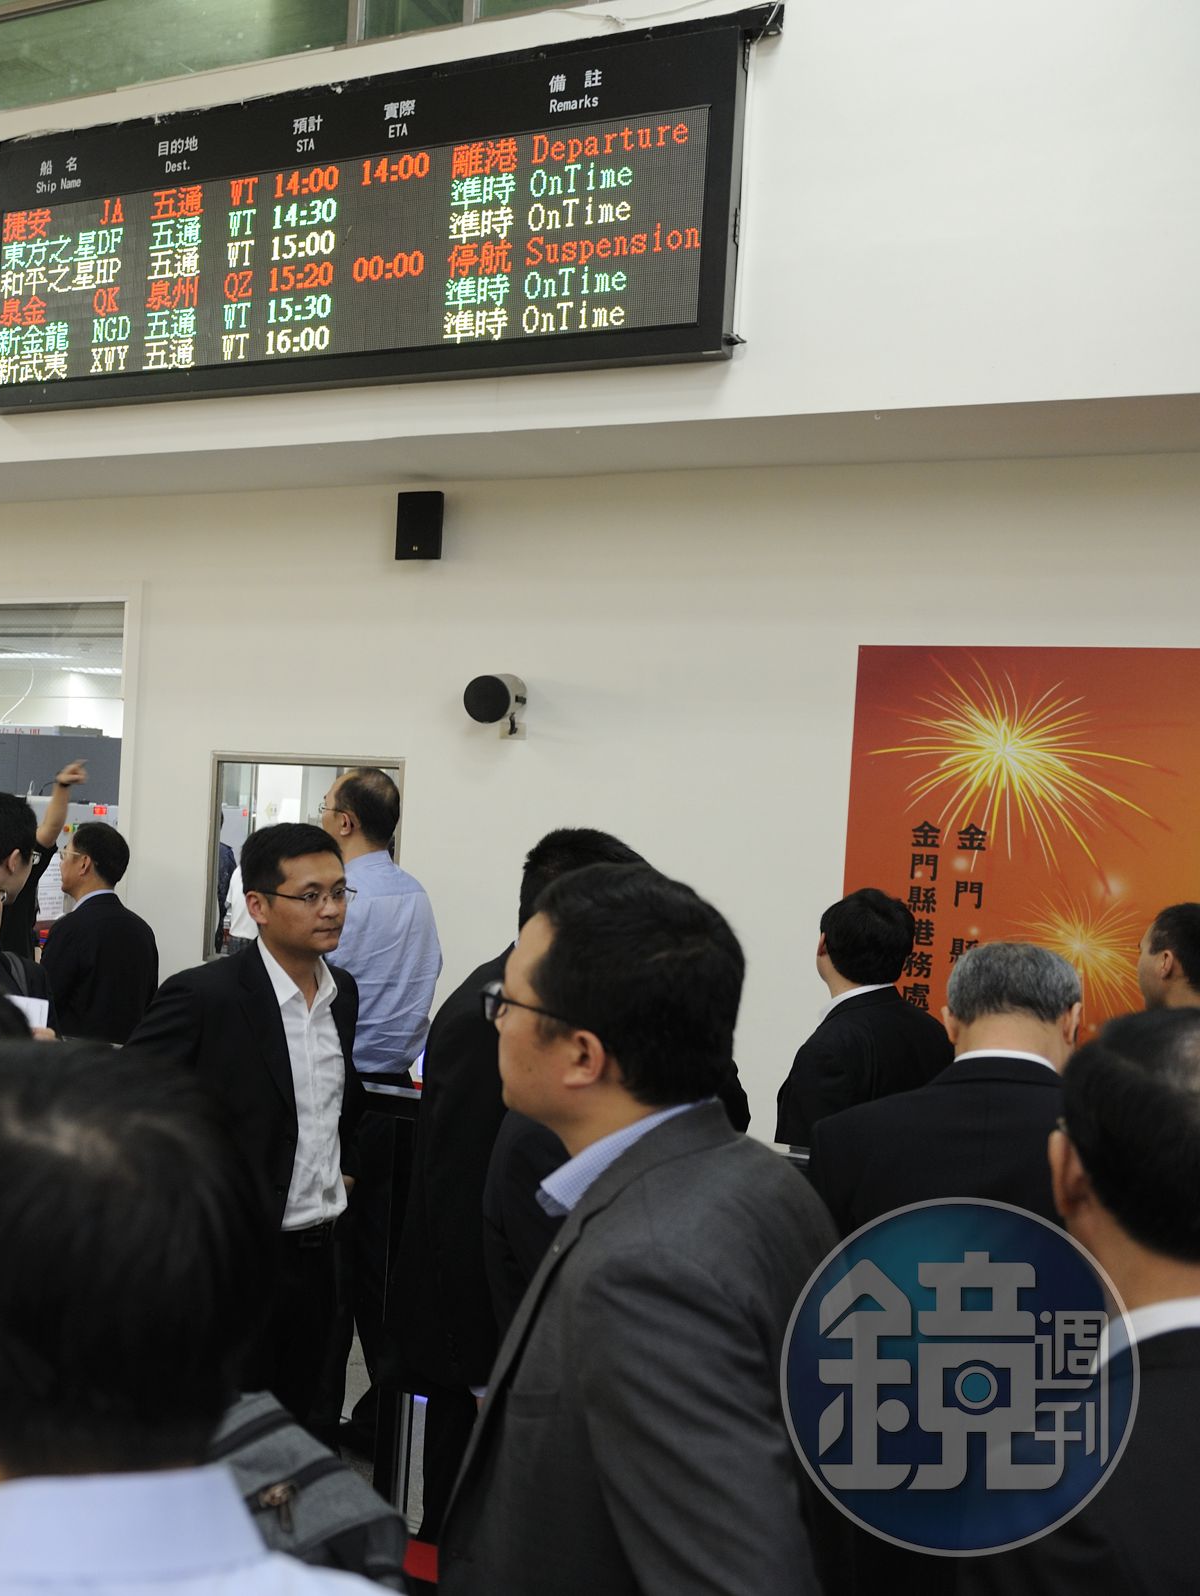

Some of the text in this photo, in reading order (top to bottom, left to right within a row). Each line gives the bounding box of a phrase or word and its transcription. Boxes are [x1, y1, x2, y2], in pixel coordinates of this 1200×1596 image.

[549, 69, 602, 93] 備註
[383, 100, 415, 120] 實際
[549, 95, 599, 113] Remarks
[292, 114, 323, 135] 預計
[388, 124, 408, 138] ETA
[157, 136, 198, 157] 目的地
[296, 138, 315, 153] STA
[165, 159, 191, 174] Dest.
[3, 122, 689, 242] 捷安 JA 五通 WT 14:00 14:00 離港 Departure
[36, 177, 81, 194] Ship Name
[149, 216, 202, 251] 五通
[228, 209, 256, 237] WT
[272, 198, 337, 230] 14:30
[451, 172, 516, 211] 準時
[529, 162, 633, 199] OnTime
[148, 246, 200, 280] 五通
[226, 241, 255, 269] WT
[270, 230, 336, 262] 15:00
[449, 206, 514, 244] 準時
[528, 197, 631, 232] OnTime
[92, 287, 120, 317] QK
[145, 276, 199, 311] 泉州
[224, 271, 253, 302] QZ
[268, 262, 334, 293] 15:20
[352, 251, 424, 283] 00:00
[447, 239, 513, 280] 停航
[525, 223, 700, 267] Suspension
[92, 316, 131, 344] NGD
[143, 307, 197, 341] 五通
[223, 302, 252, 329] WT
[266, 294, 332, 324] 15:30
[444, 273, 510, 311] 準時
[524, 265, 627, 300] OnTime
[90, 345, 129, 373] XWY
[142, 338, 196, 371] 五通
[221, 333, 250, 360] WT
[265, 325, 330, 356] 16:00
[443, 307, 508, 344] 準時
[522, 301, 625, 335] OnTime
